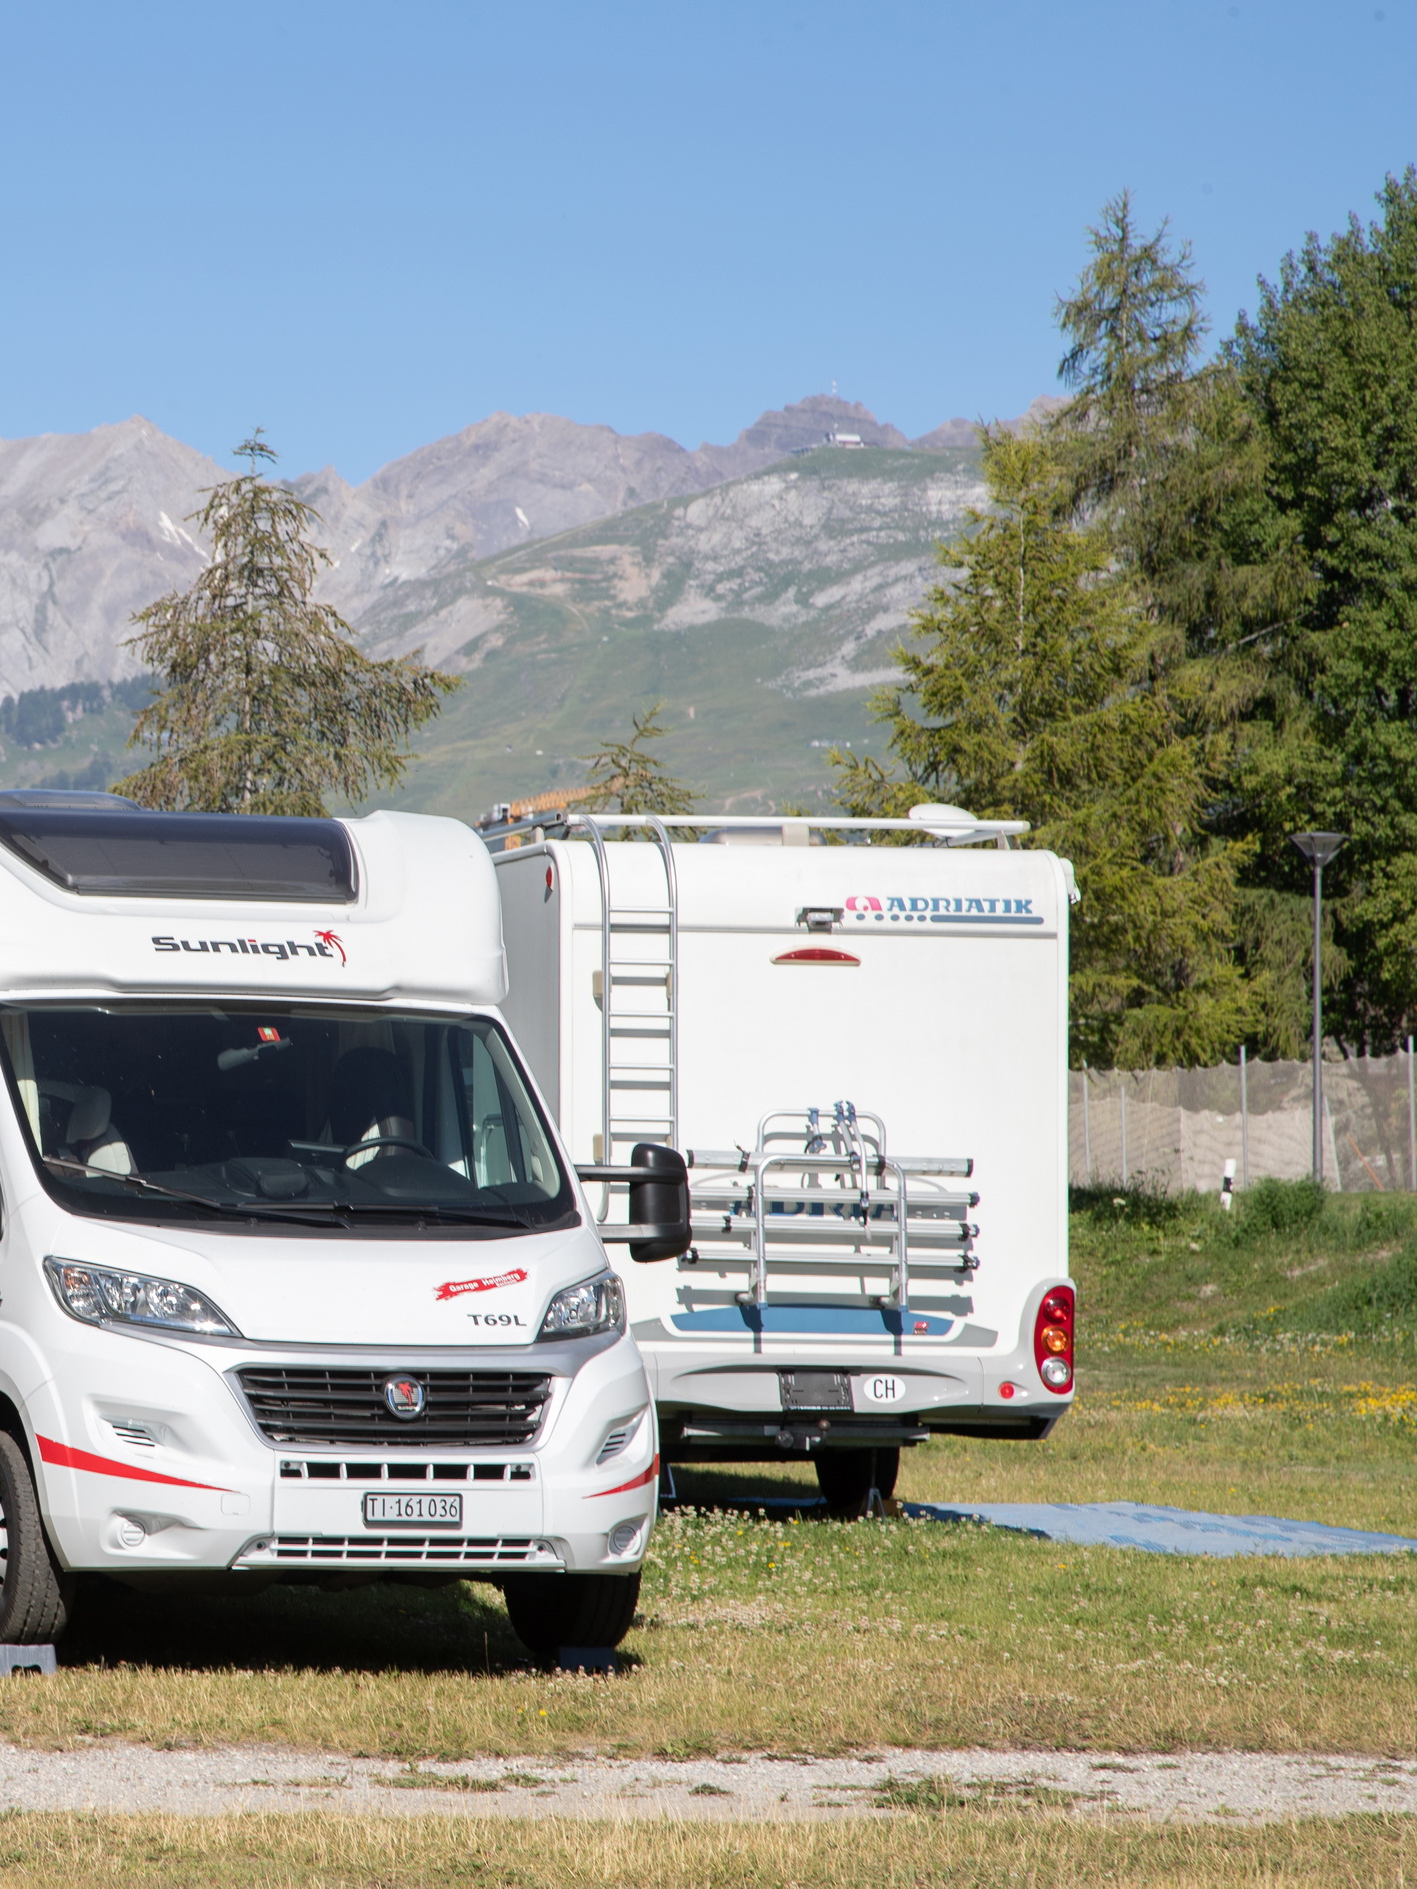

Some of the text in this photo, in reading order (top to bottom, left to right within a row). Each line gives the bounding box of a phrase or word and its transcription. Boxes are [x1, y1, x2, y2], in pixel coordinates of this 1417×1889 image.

[886, 896, 1033, 914] ADRIATIK
[151, 935, 334, 961] Sunlight
[449, 1281, 480, 1292] Garage
[466, 1313, 528, 1327] T69L
[873, 1378, 896, 1399] CH
